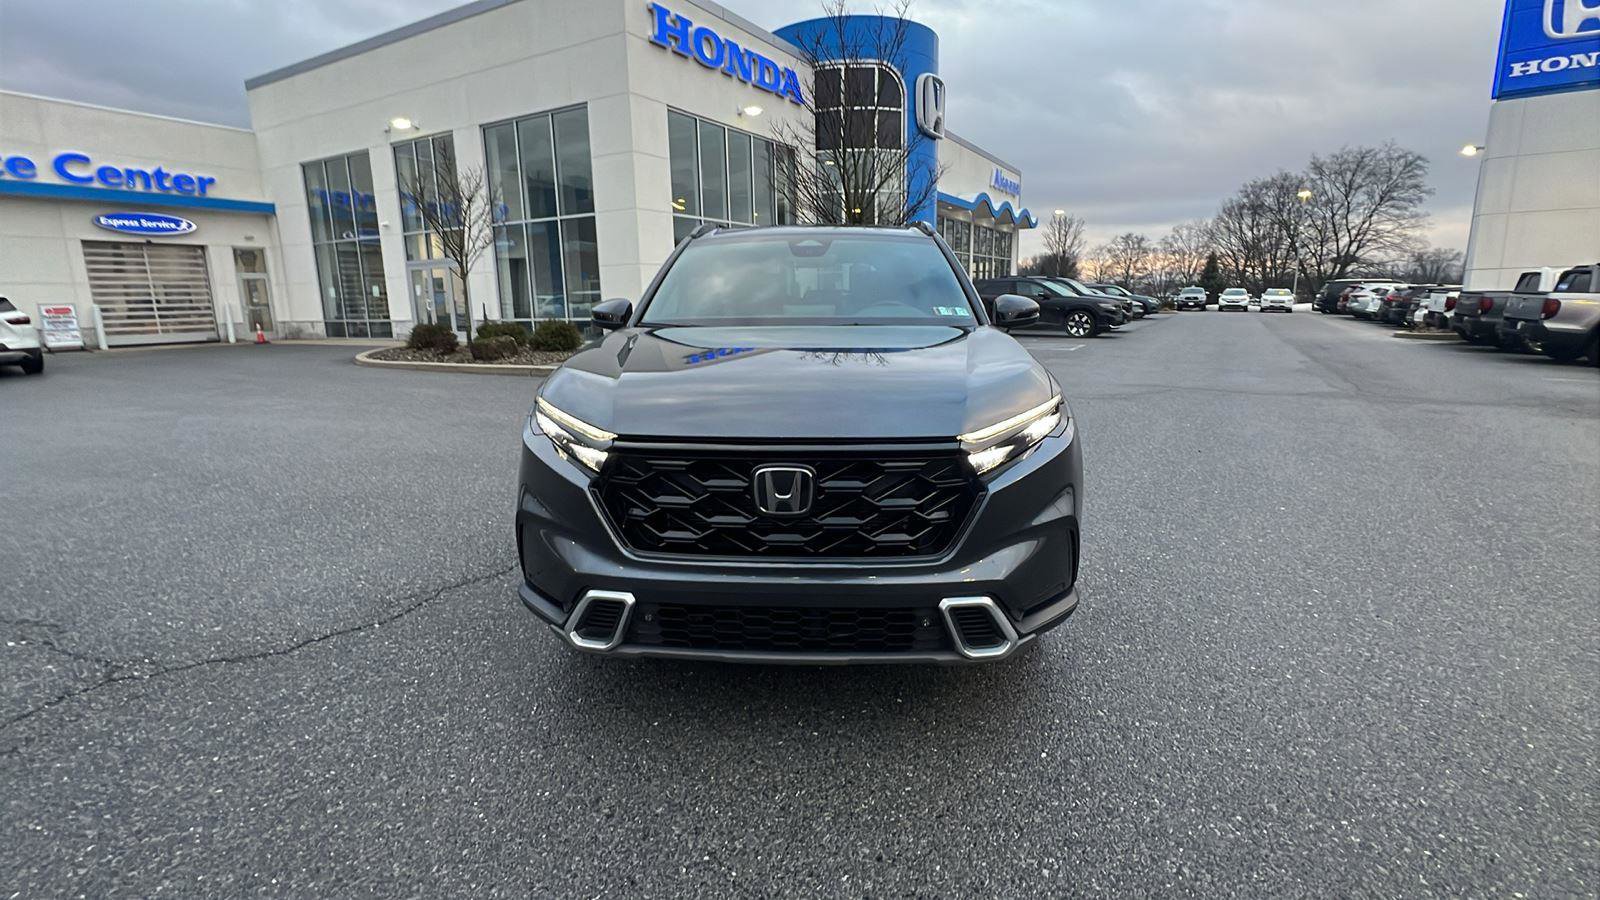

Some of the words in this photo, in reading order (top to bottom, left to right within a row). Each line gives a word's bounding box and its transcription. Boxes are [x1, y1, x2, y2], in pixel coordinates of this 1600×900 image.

[648, 3, 804, 105] HONDA
[1508, 51, 1600, 77] HON
[0, 156, 37, 179] e
[53, 152, 216, 194] Center
[99, 216, 140, 228] Express
[140, 218, 176, 229] Service
